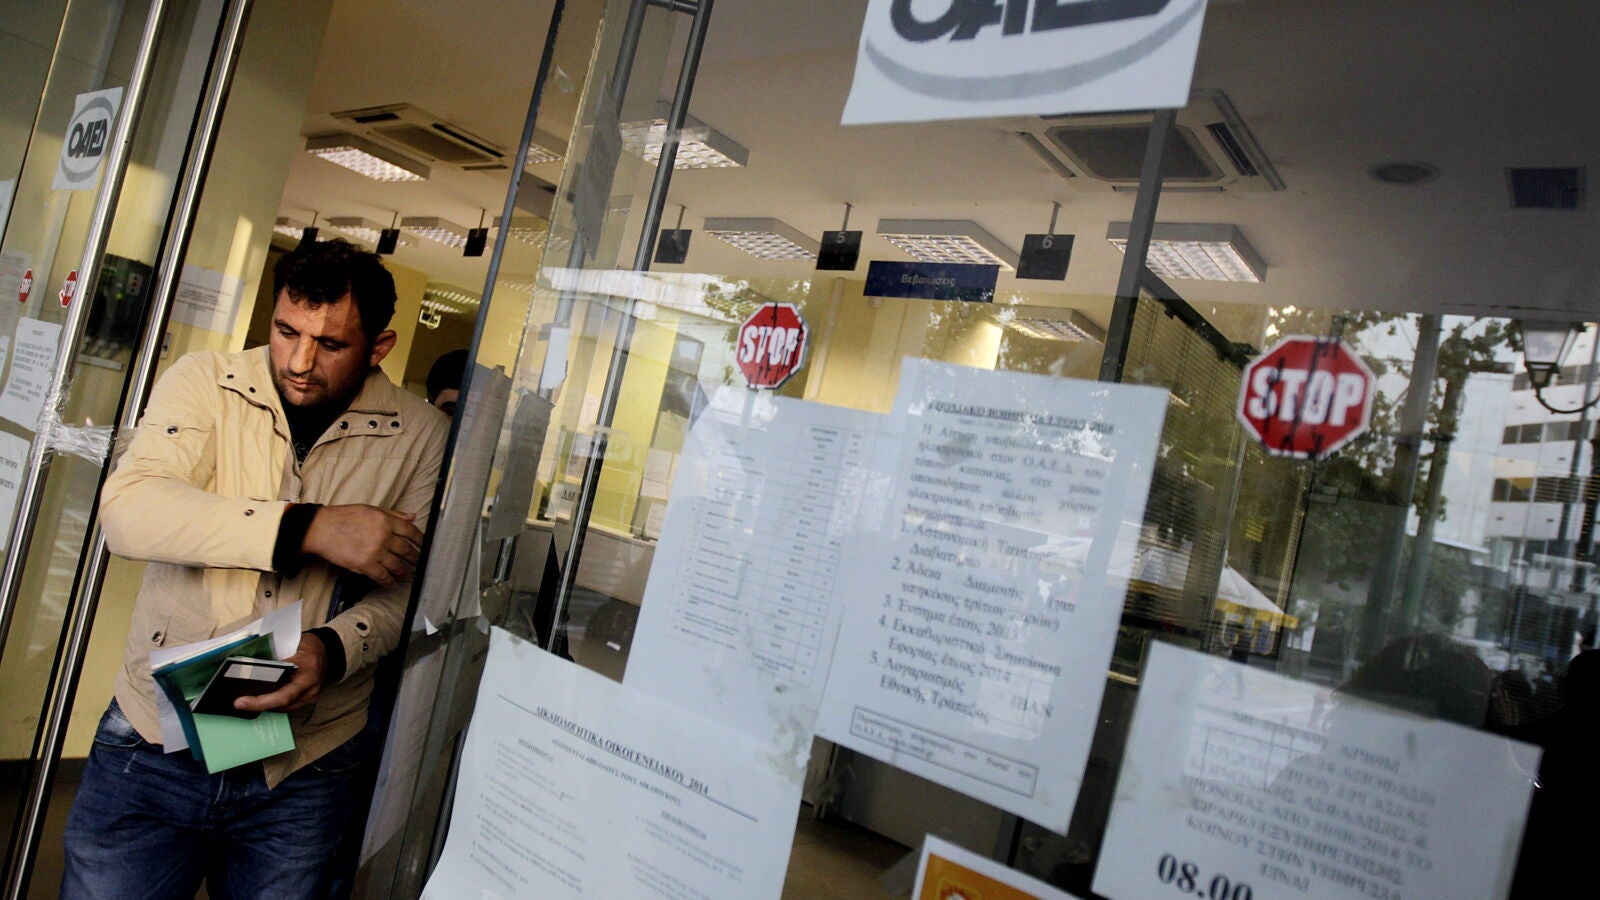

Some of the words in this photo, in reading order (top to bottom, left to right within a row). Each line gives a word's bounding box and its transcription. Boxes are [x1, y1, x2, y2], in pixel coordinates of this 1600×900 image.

[838, 231, 846, 244] 5
[1042, 235, 1052, 250] 6
[901, 273, 956, 287] Βεβαιώσεις
[740, 325, 799, 366] STOP
[1248, 366, 1365, 426] STOP
[900, 520, 912, 533] 1.
[962, 574, 1025, 604] Διαμονής
[891, 616, 985, 660] Εκκαθαριστικό
[947, 611, 985, 636] έτους
[868, 650, 881, 667] 5.
[883, 653, 967, 698] Λογαριασμός
[887, 635, 938, 666] Εφορίας
[940, 652, 976, 677] έτους
[878, 673, 927, 705] Εθνικής
[536, 706, 603, 748] ΔΙΚΑΙΟΛΟΓΗΤΙΚΑ
[604, 739, 685, 783] ΟΙΚΟΓΕΝΕΙΑΚΟΥ
[688, 777, 709, 795] 2014
[1179, 774, 1267, 813] ΠΡΟΝΟΙΑΣ
[1183, 815, 1252, 848] ΚΟΙΝΟΥ
[1254, 842, 1305, 868] ΣΤΗΝ
[1251, 820, 1409, 885] ΕΞΥΠΗΡΕΤΗΣΗΣ
[1157, 853, 1253, 900] 08.00
[1257, 862, 1312, 893] ΕΙΝΑΙ
